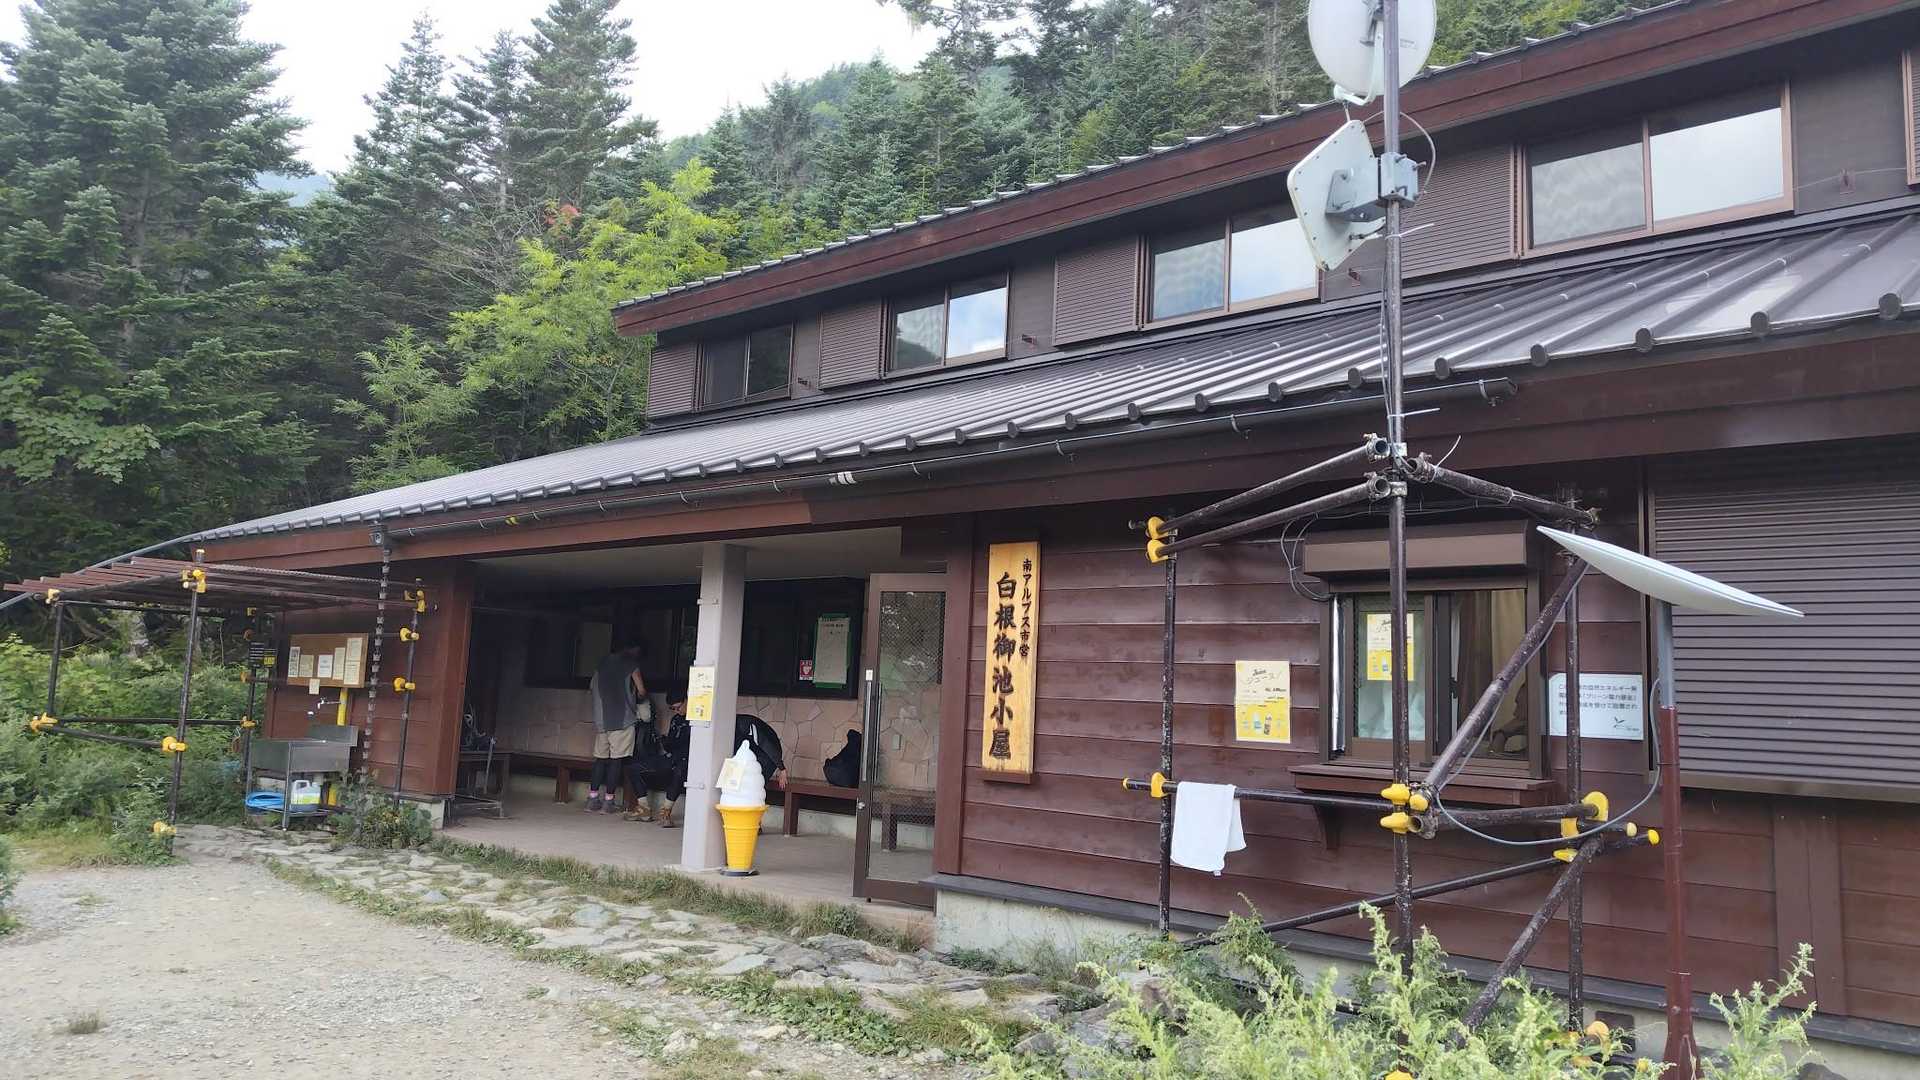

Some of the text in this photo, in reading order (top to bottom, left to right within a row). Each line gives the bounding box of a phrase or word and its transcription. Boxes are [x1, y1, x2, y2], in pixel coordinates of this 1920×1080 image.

[989, 571, 1017, 759] 白根御池小屋
[1019, 558, 1033, 657] 南アルプス市営
